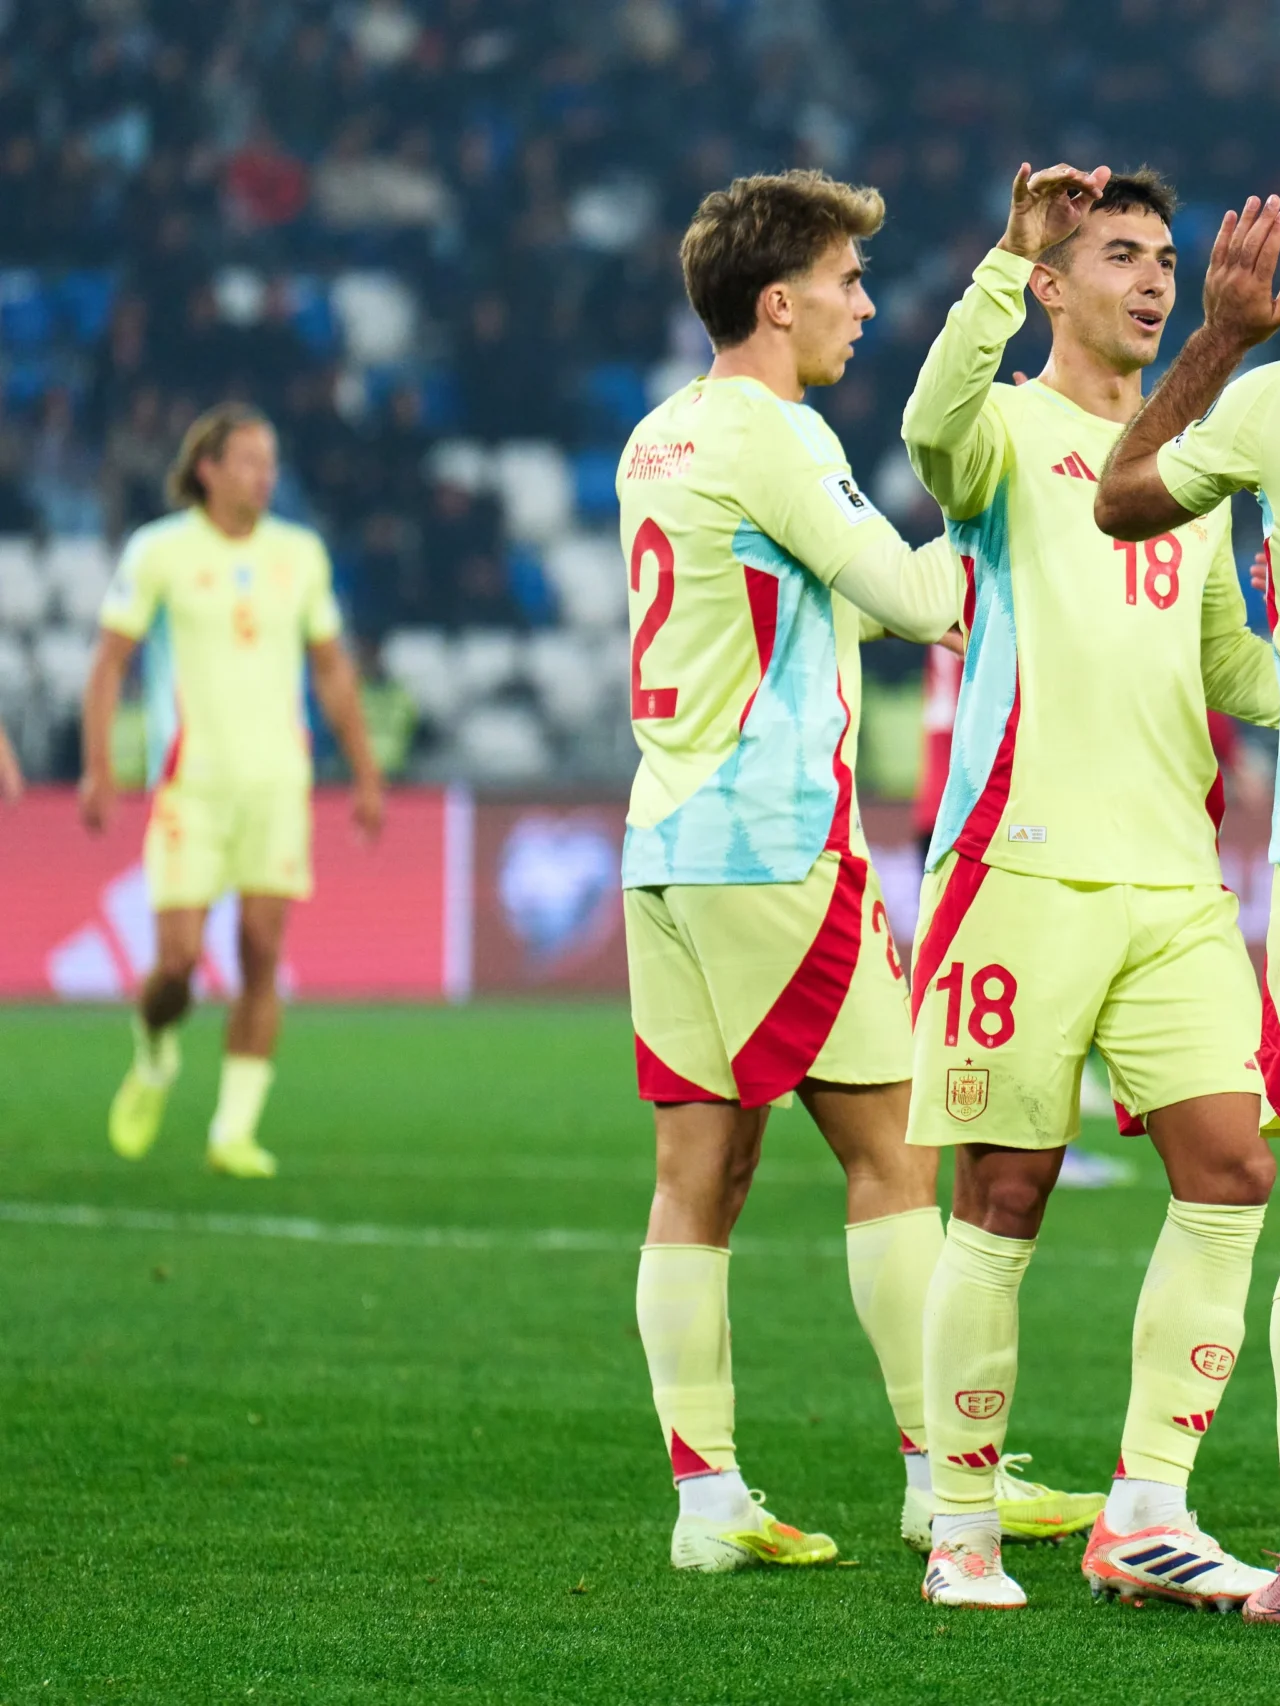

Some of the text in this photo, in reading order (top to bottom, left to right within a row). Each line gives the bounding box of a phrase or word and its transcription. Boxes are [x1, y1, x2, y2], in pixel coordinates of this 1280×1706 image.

[1113, 531, 1182, 610] 18
[631, 517, 678, 720] 2
[872, 900, 903, 980] 2
[936, 962, 1017, 1049] 18
